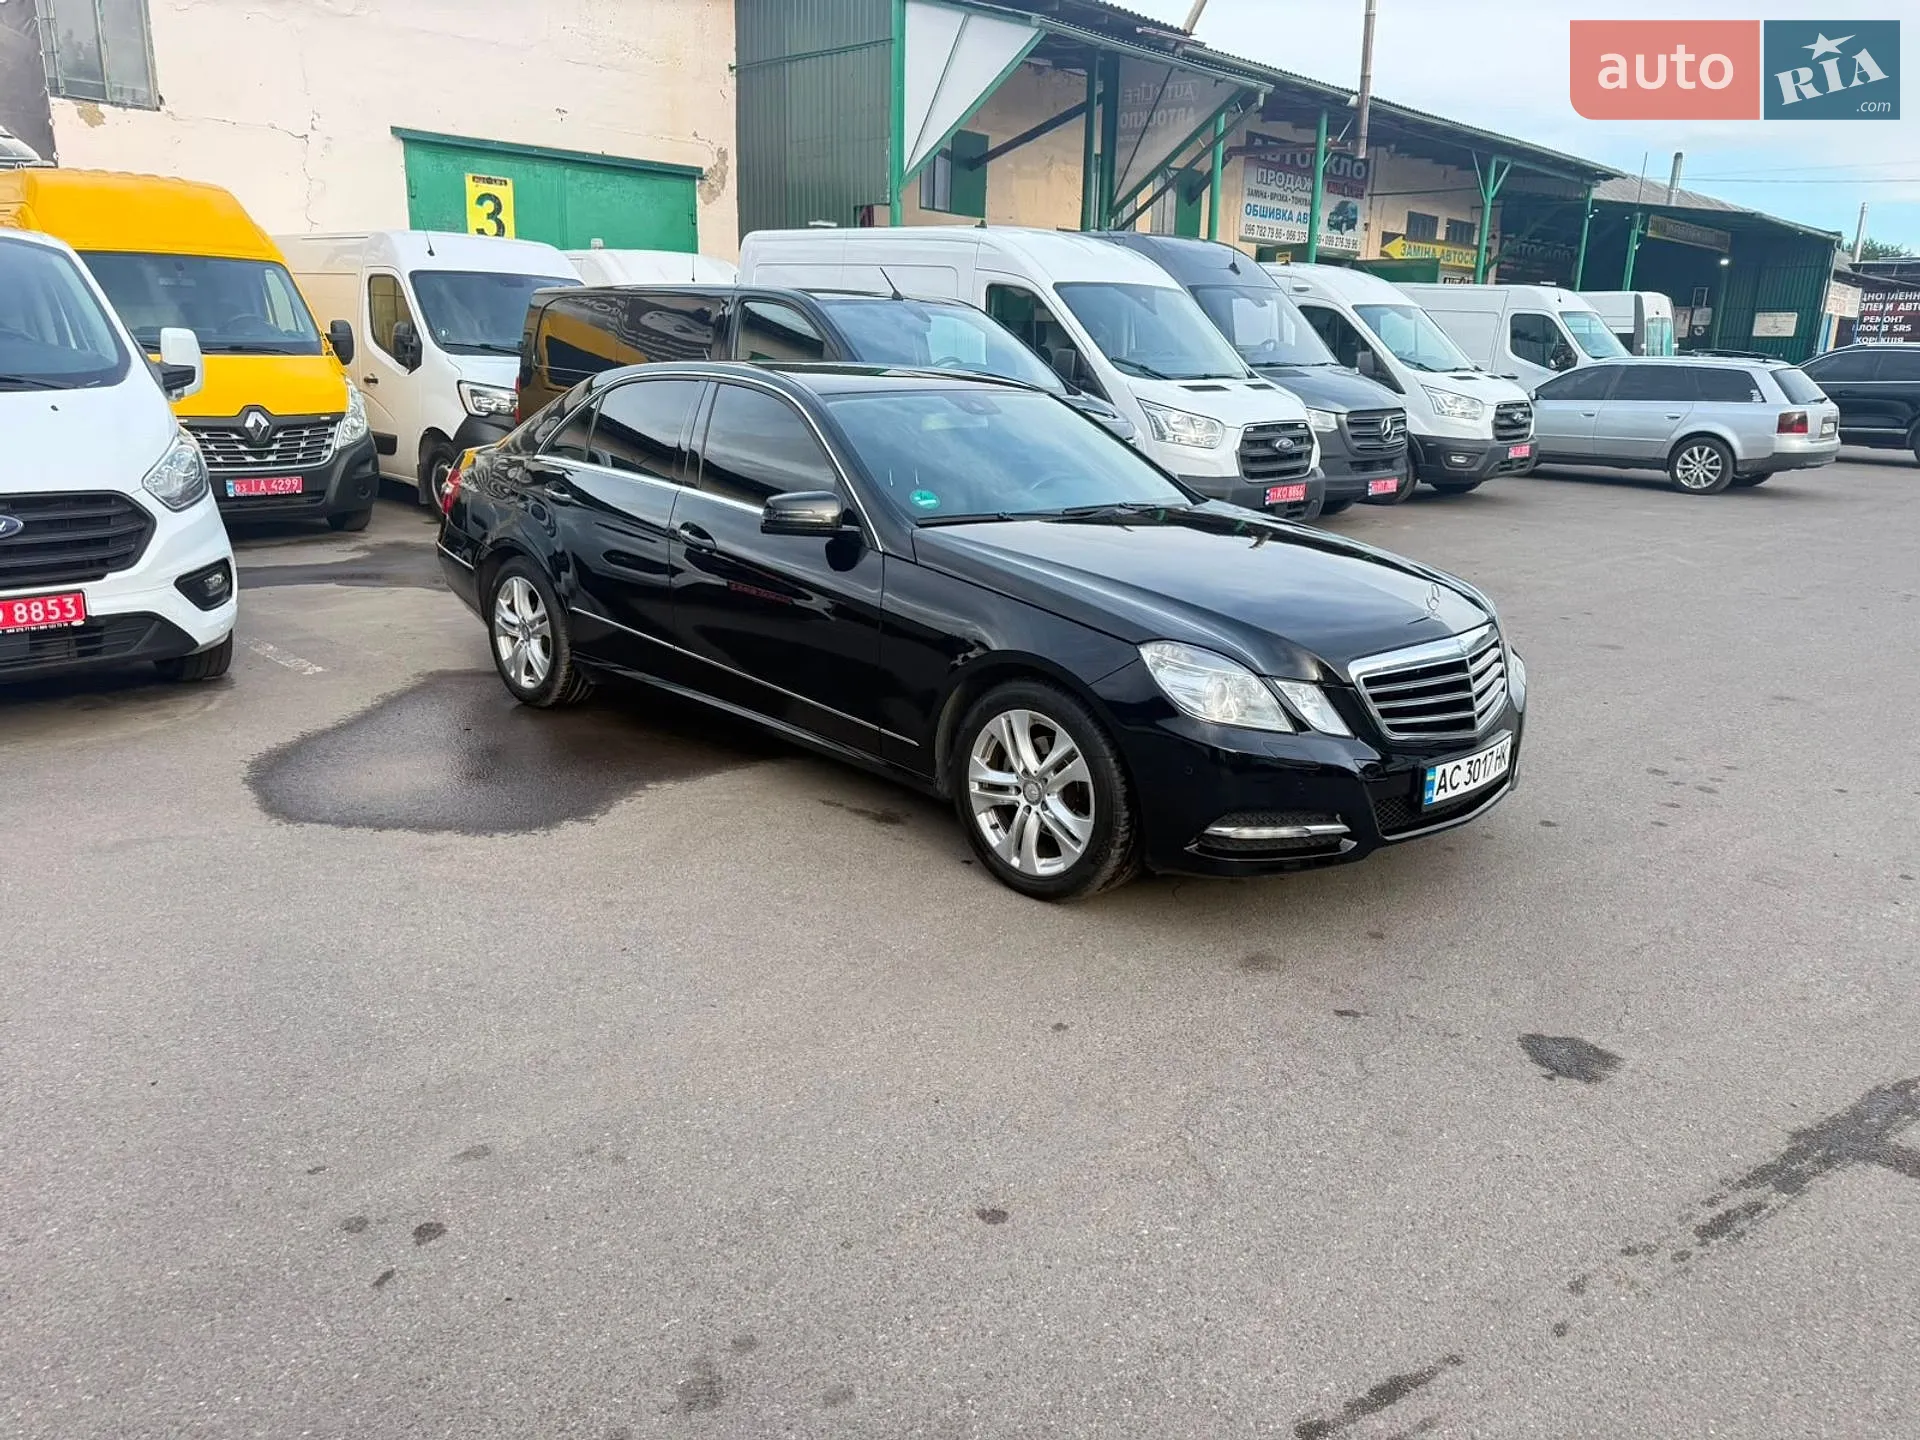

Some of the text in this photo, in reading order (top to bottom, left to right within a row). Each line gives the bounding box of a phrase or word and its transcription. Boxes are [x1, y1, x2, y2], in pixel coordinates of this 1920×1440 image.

[1252, 138, 1366, 179] АВТОКЛО
[475, 192, 506, 237] 3
[1245, 202, 1294, 222] ОБШИВКА
[1893, 324, 1912, 332] SRS
[270, 478, 299, 491] 4299
[13, 597, 77, 624] 8853
[1435, 764, 1462, 796] AC
[1463, 750, 1494, 786] 3017
